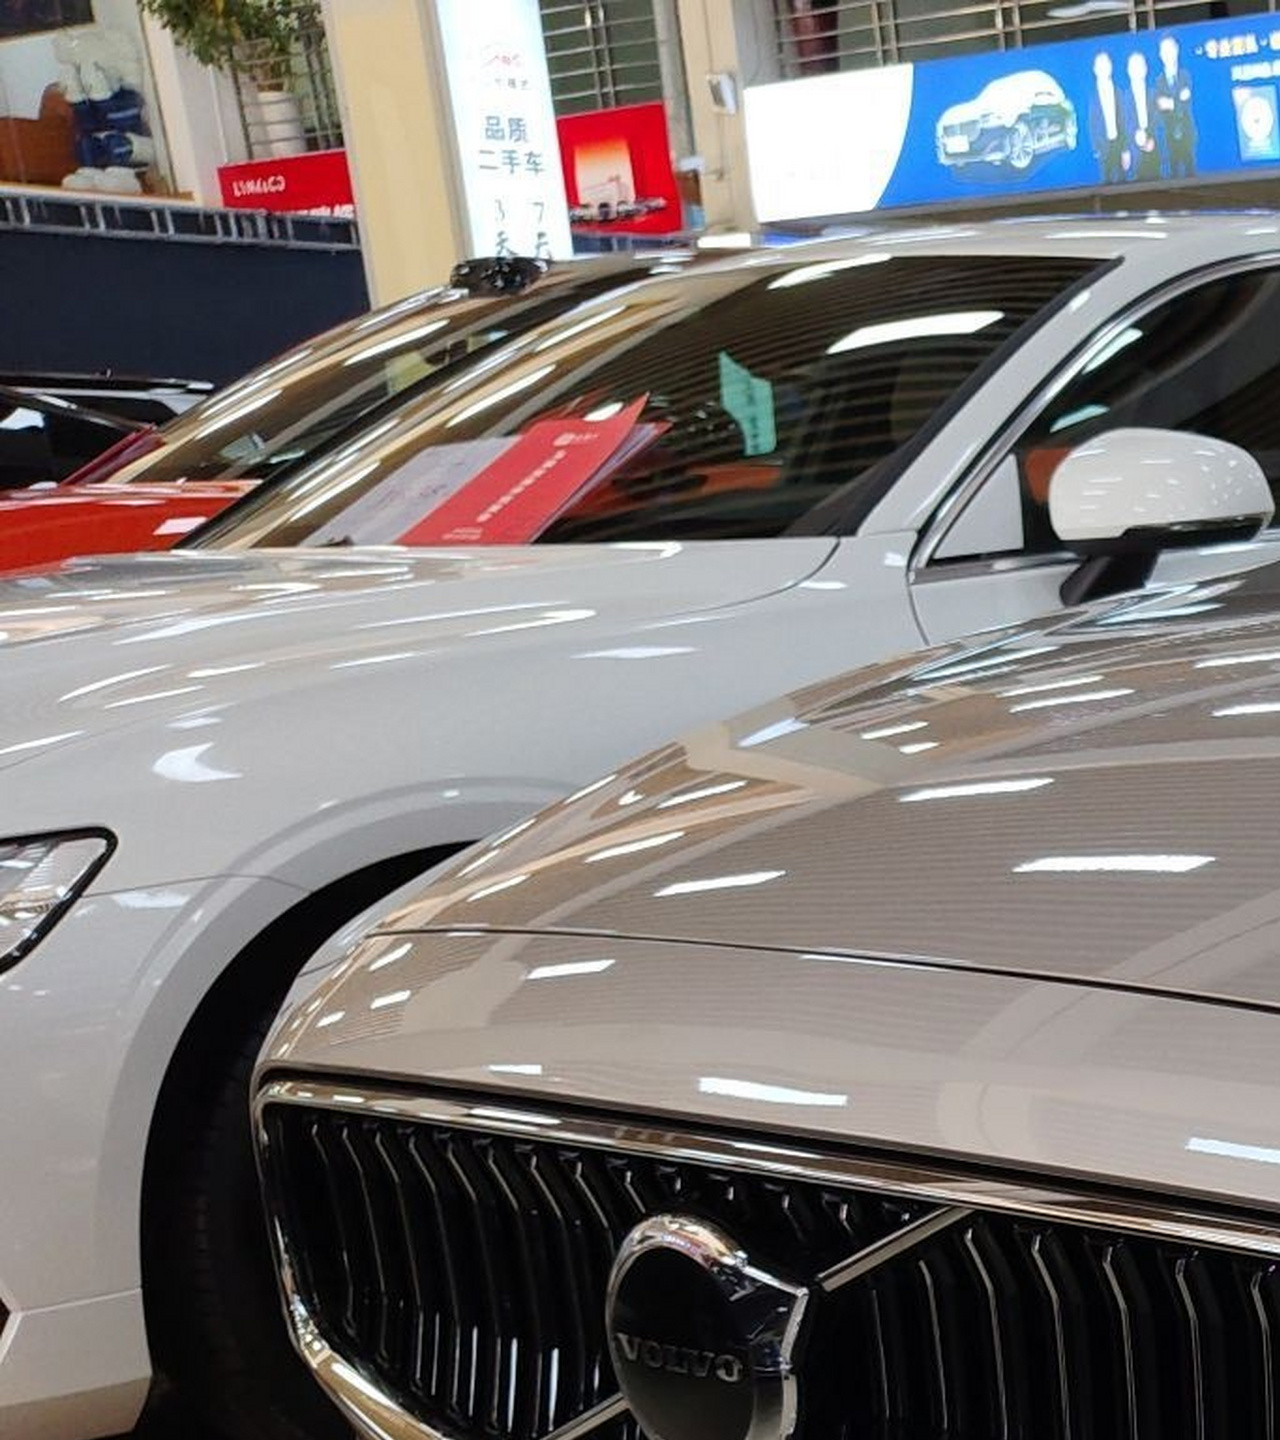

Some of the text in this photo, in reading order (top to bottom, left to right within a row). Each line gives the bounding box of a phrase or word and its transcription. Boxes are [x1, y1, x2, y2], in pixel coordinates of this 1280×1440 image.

[484, 115, 529, 143] 品质
[478, 148, 546, 176] 二手车
[615, 1332, 744, 1383] VOLVO
